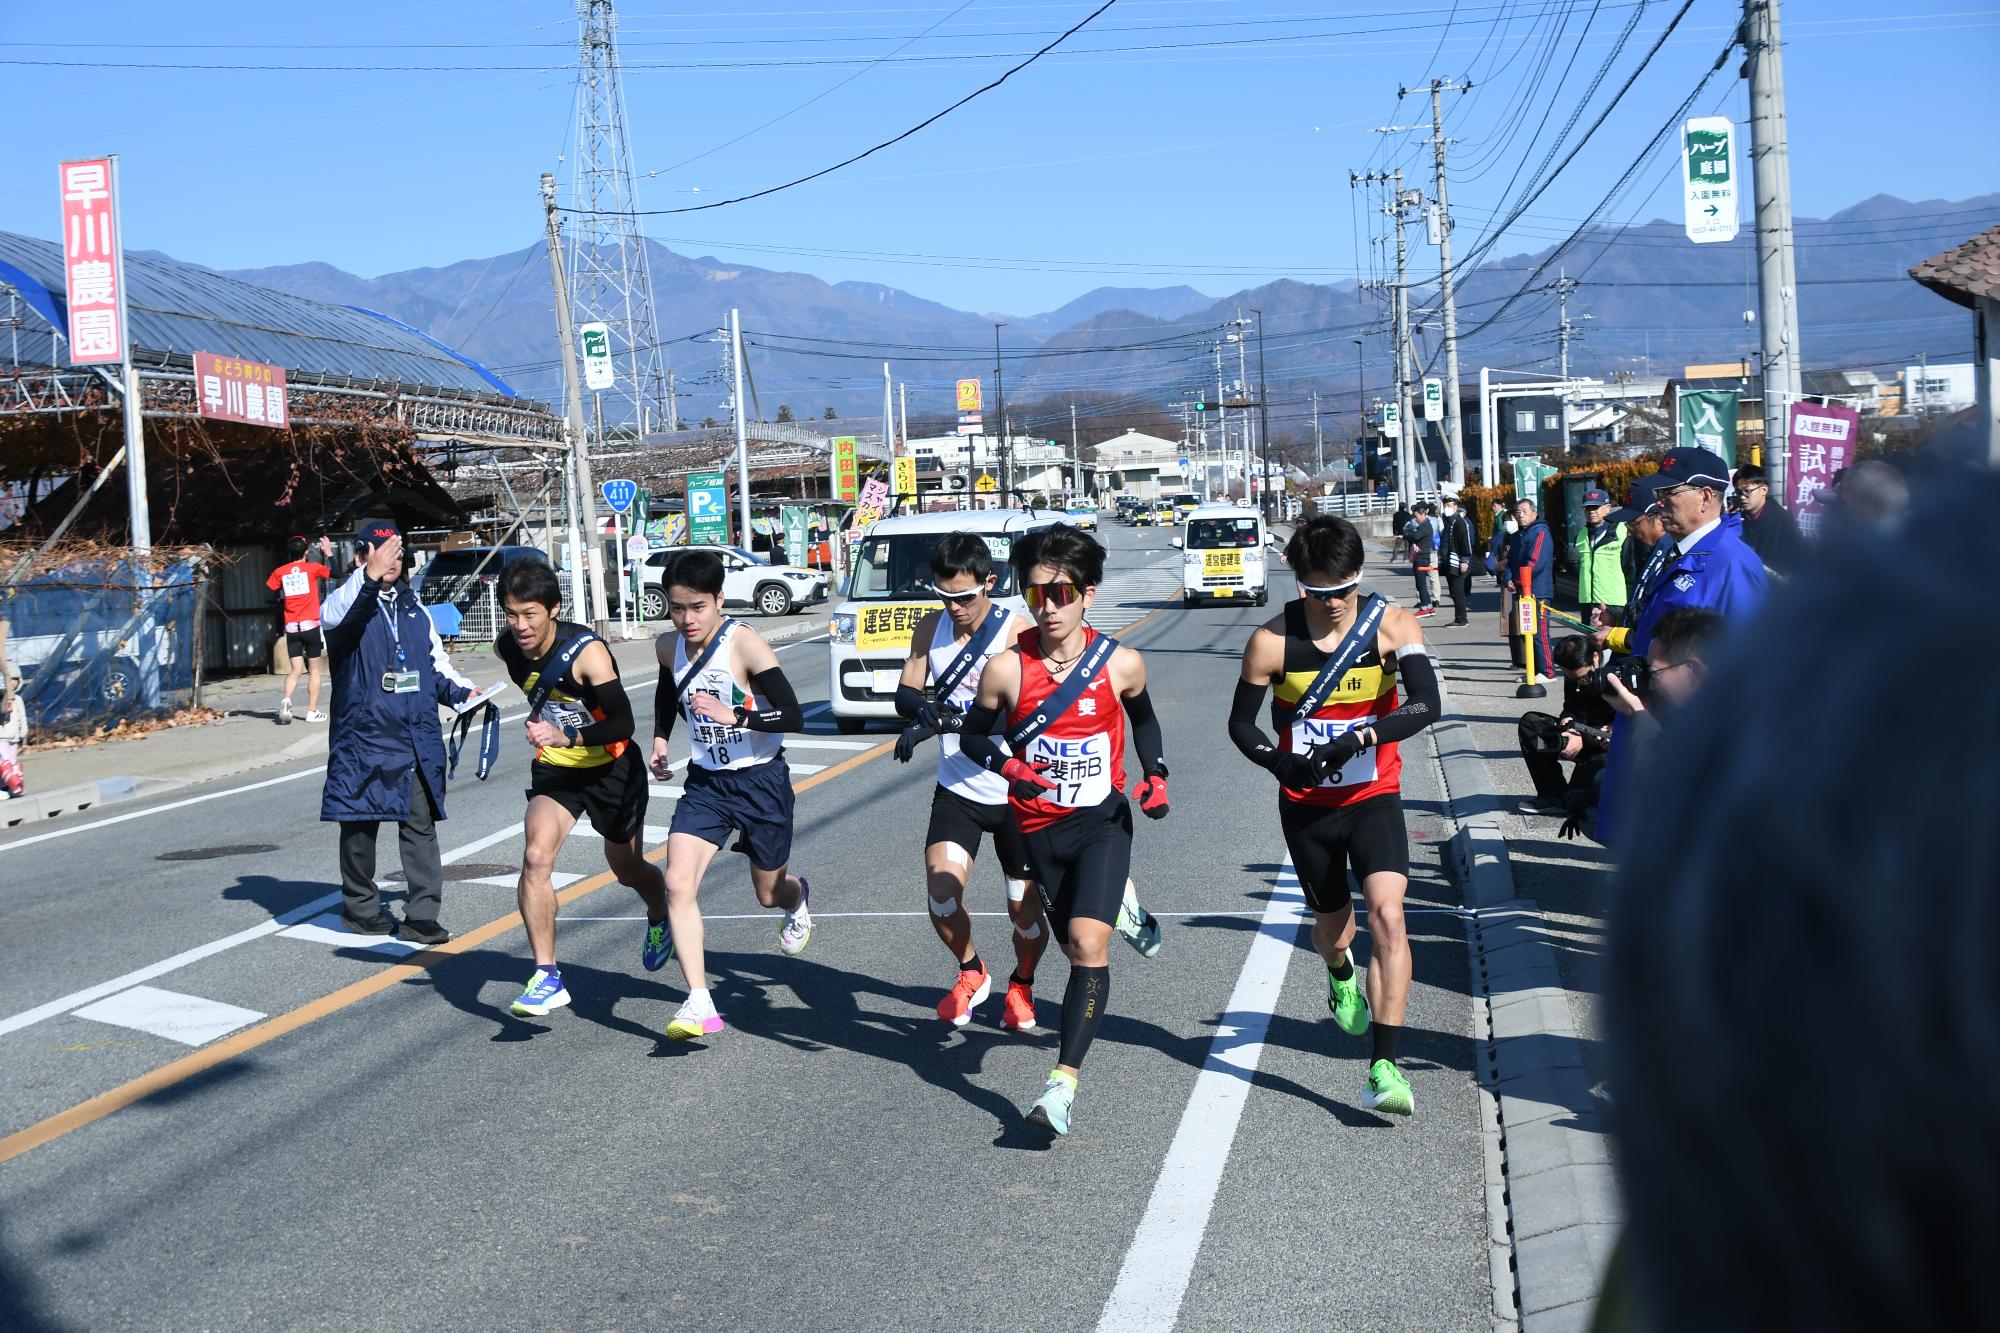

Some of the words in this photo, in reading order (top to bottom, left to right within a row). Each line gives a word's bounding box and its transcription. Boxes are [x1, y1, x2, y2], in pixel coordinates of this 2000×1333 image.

[1691, 189, 1731, 200] 入園無料
[65, 164, 117, 357] 早川農園
[214, 359, 272, 383] ぶどう狩りの
[203, 375, 286, 425] 早川農園
[1801, 420, 1843, 436] 入館無料
[610, 488, 629, 500] 411
[691, 491, 712, 515] P
[1296, 695, 1318, 719] NEC
[694, 726, 743, 745] 上野原市
[707, 747, 731, 765] 18
[1038, 738, 1099, 758] NEC
[1033, 754, 1102, 781] 甲斐市B
[1055, 782, 1083, 804] 17
